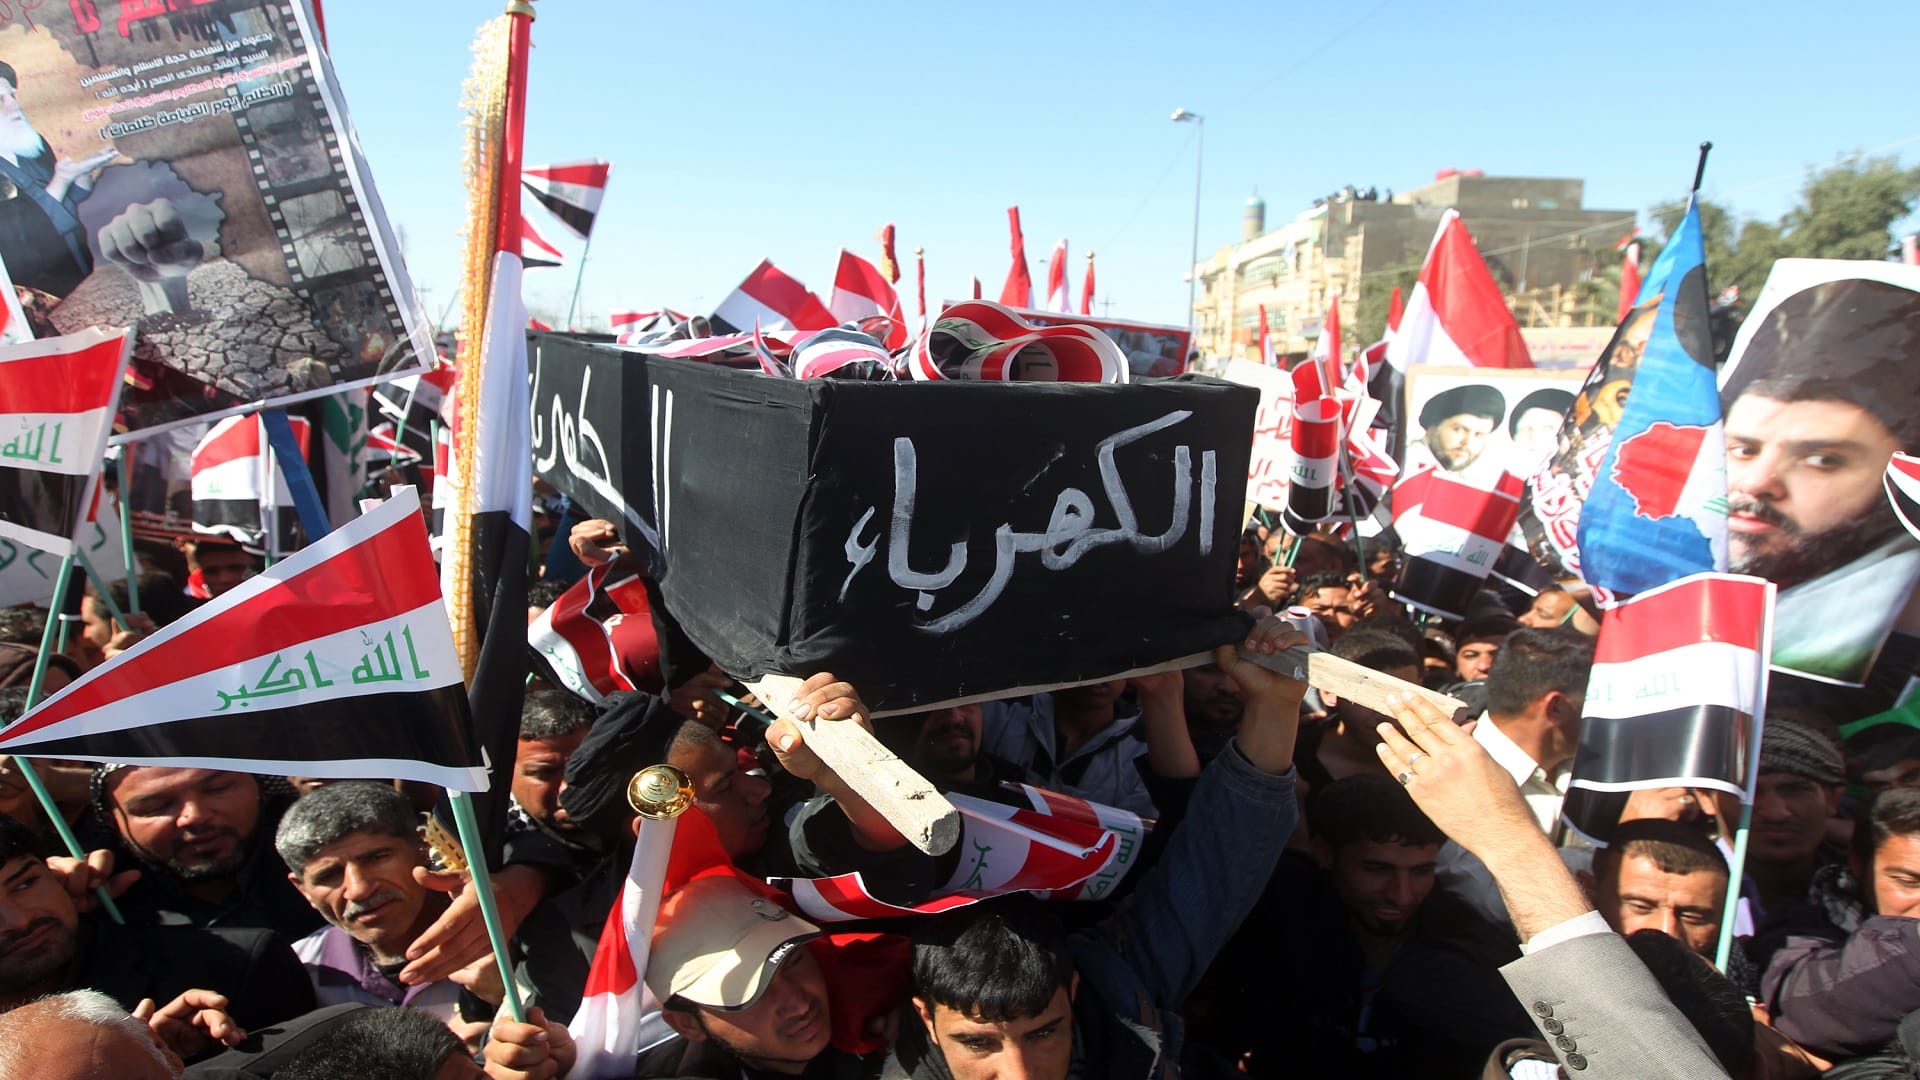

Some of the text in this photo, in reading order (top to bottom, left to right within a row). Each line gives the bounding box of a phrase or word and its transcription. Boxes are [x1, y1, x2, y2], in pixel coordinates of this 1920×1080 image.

[224, 39, 240, 52] من
[241, 32, 273, 46] بدعوة
[189, 42, 224, 59] سماحة
[241, 49, 269, 63] السيد
[164, 53, 188, 65] حجة
[213, 56, 240, 71] القائد
[80, 66, 132, 87] والمسلمين
[149, 72, 175, 88] الصدر
[176, 65, 211, 80] مقتدى
[156, 101, 209, 126] القيامة
[210, 95, 241, 116] يوم
[2, 416, 63, 464] الله
[839, 409, 1217, 635] الكهرباء
[352, 624, 430, 685] الله
